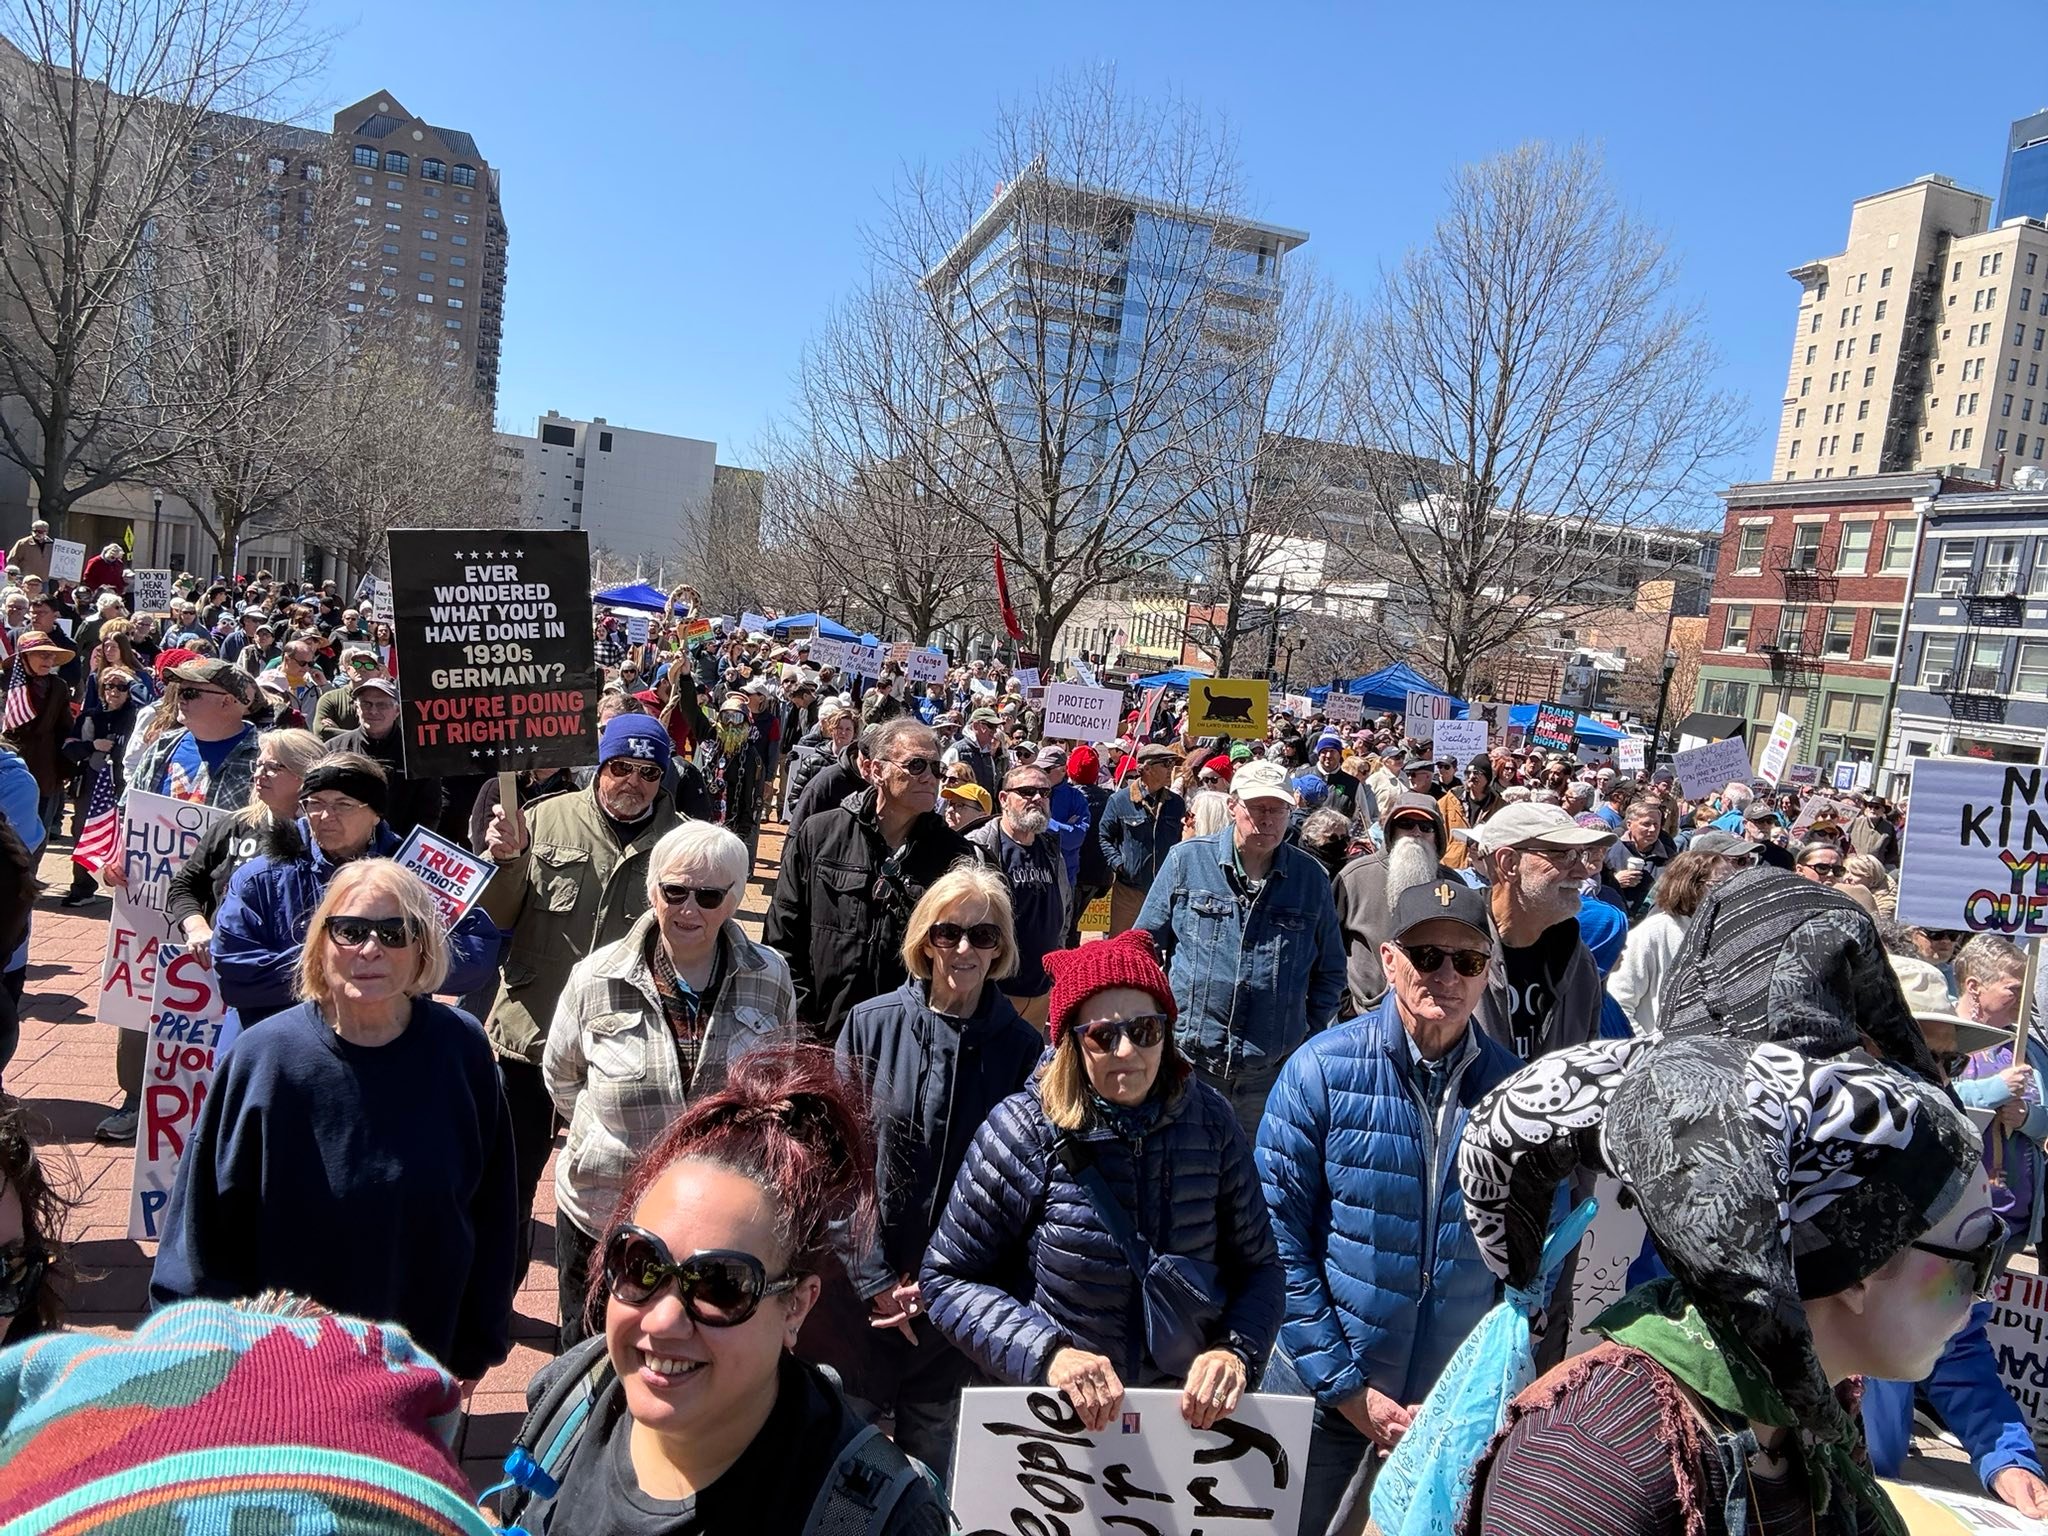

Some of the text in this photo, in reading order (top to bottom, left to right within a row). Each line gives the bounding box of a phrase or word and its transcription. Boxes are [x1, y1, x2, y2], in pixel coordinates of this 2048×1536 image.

[140, 572, 168, 580] DO YOU
[465, 565, 518, 582] EVER
[140, 589, 168, 599] PEOPLE
[143, 581, 163, 590] HEAR
[434, 584, 550, 603] WONDERED
[142, 599, 167, 610] SING?
[430, 603, 557, 623] WHAT YOU'D
[425, 622, 565, 643] HAVE DONE IN
[463, 643, 532, 665] 1930s
[851, 644, 875, 659] USA
[432, 663, 566, 690] GERMANY?
[415, 691, 584, 721] YOU'RE DOING
[1058, 694, 1104, 710] PROTECT
[1408, 691, 1428, 718] ICE
[1539, 713, 1574, 727] RIGHTS
[1542, 705, 1575, 719] TRANS
[1049, 712, 1112, 730] DEMOCRACY!
[1414, 723, 1426, 736] NO
[1537, 721, 1557, 731] ARE
[417, 715, 586, 746] IT RIGHT NOW.
[1440, 732, 1471, 744] Section
[1536, 728, 1572, 743] HUMAN
[628, 738, 655, 758] UK
[1488, 736, 1503, 746] PE
[1533, 735, 1568, 750] RIGHTS
[1697, 770, 1743, 787] ATROCITIES
[2001, 767, 2048, 806] N
[176, 806, 210, 831] O
[416, 843, 476, 886] TRUE
[405, 860, 465, 896] PATRIOTS
[1088, 904, 1109, 913] HOPE
[1080, 914, 1111, 926] JUSTIC
[162, 953, 227, 1015] S
[965, 1391, 1096, 1536] eople
